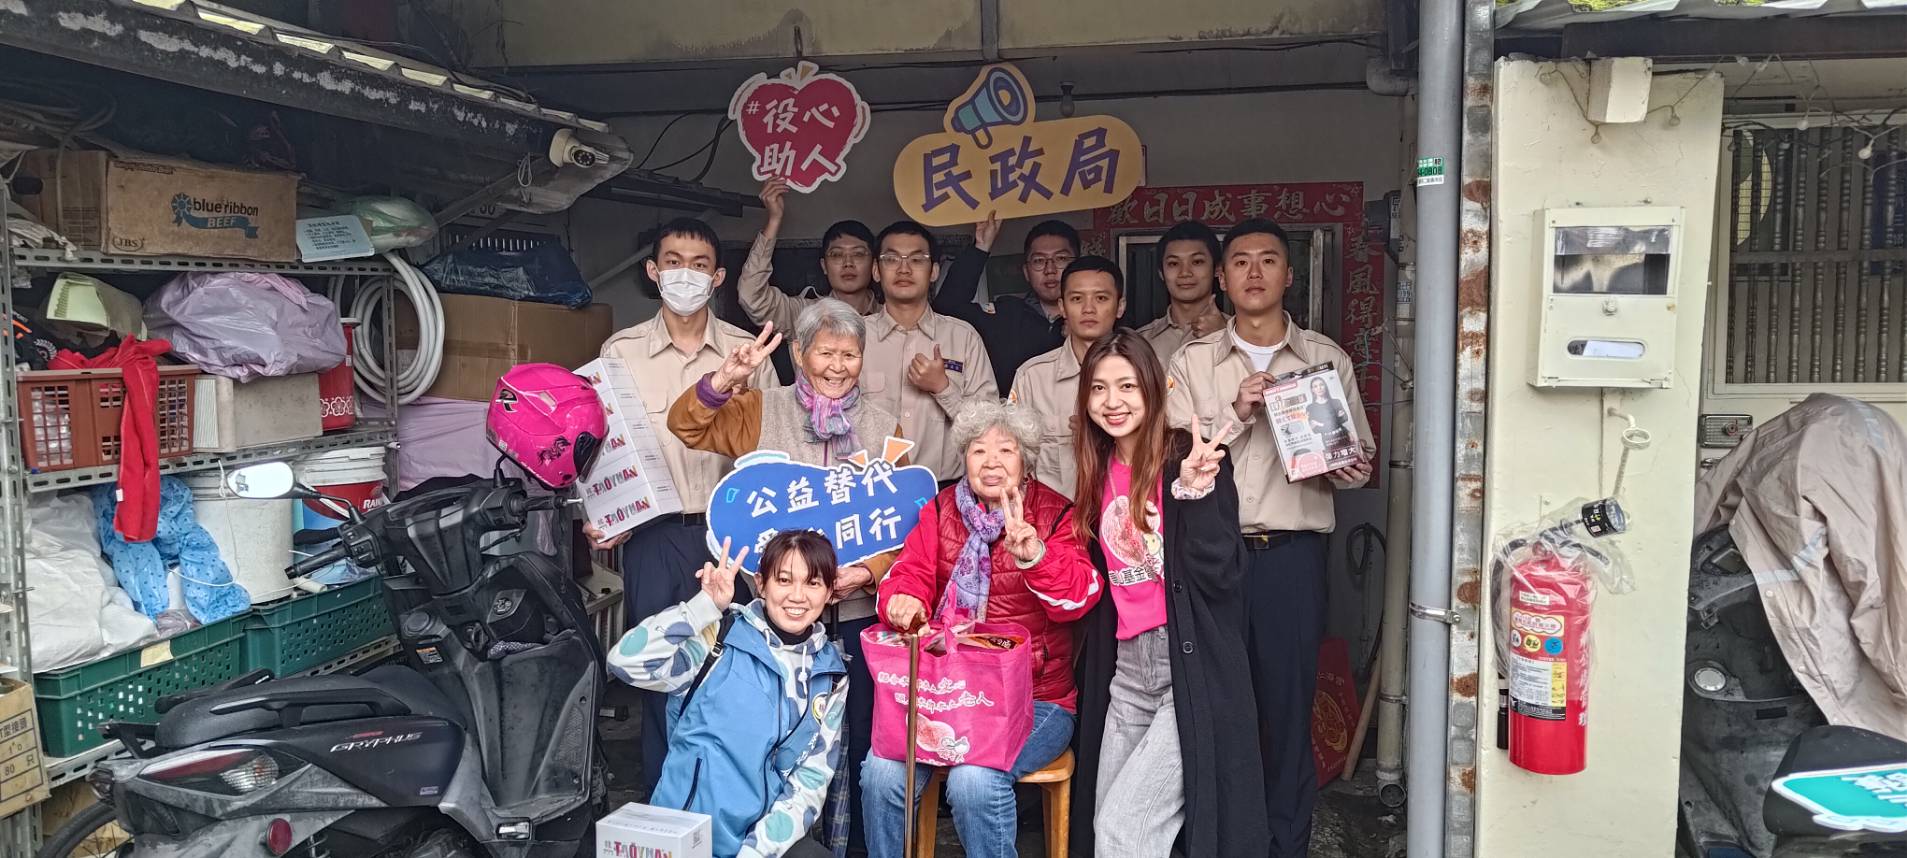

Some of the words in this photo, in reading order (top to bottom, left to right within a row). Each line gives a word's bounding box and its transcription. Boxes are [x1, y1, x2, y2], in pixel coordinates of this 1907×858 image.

[746, 98, 840, 133] #役心
[760, 141, 838, 176] 助人
[921, 127, 1121, 213] 民政局
[193, 198, 222, 213] blue
[224, 199, 259, 217] ribbon
[207, 216, 237, 228] BEEF
[747, 460, 899, 518] 公益替代
[755, 506, 901, 553] 同行
